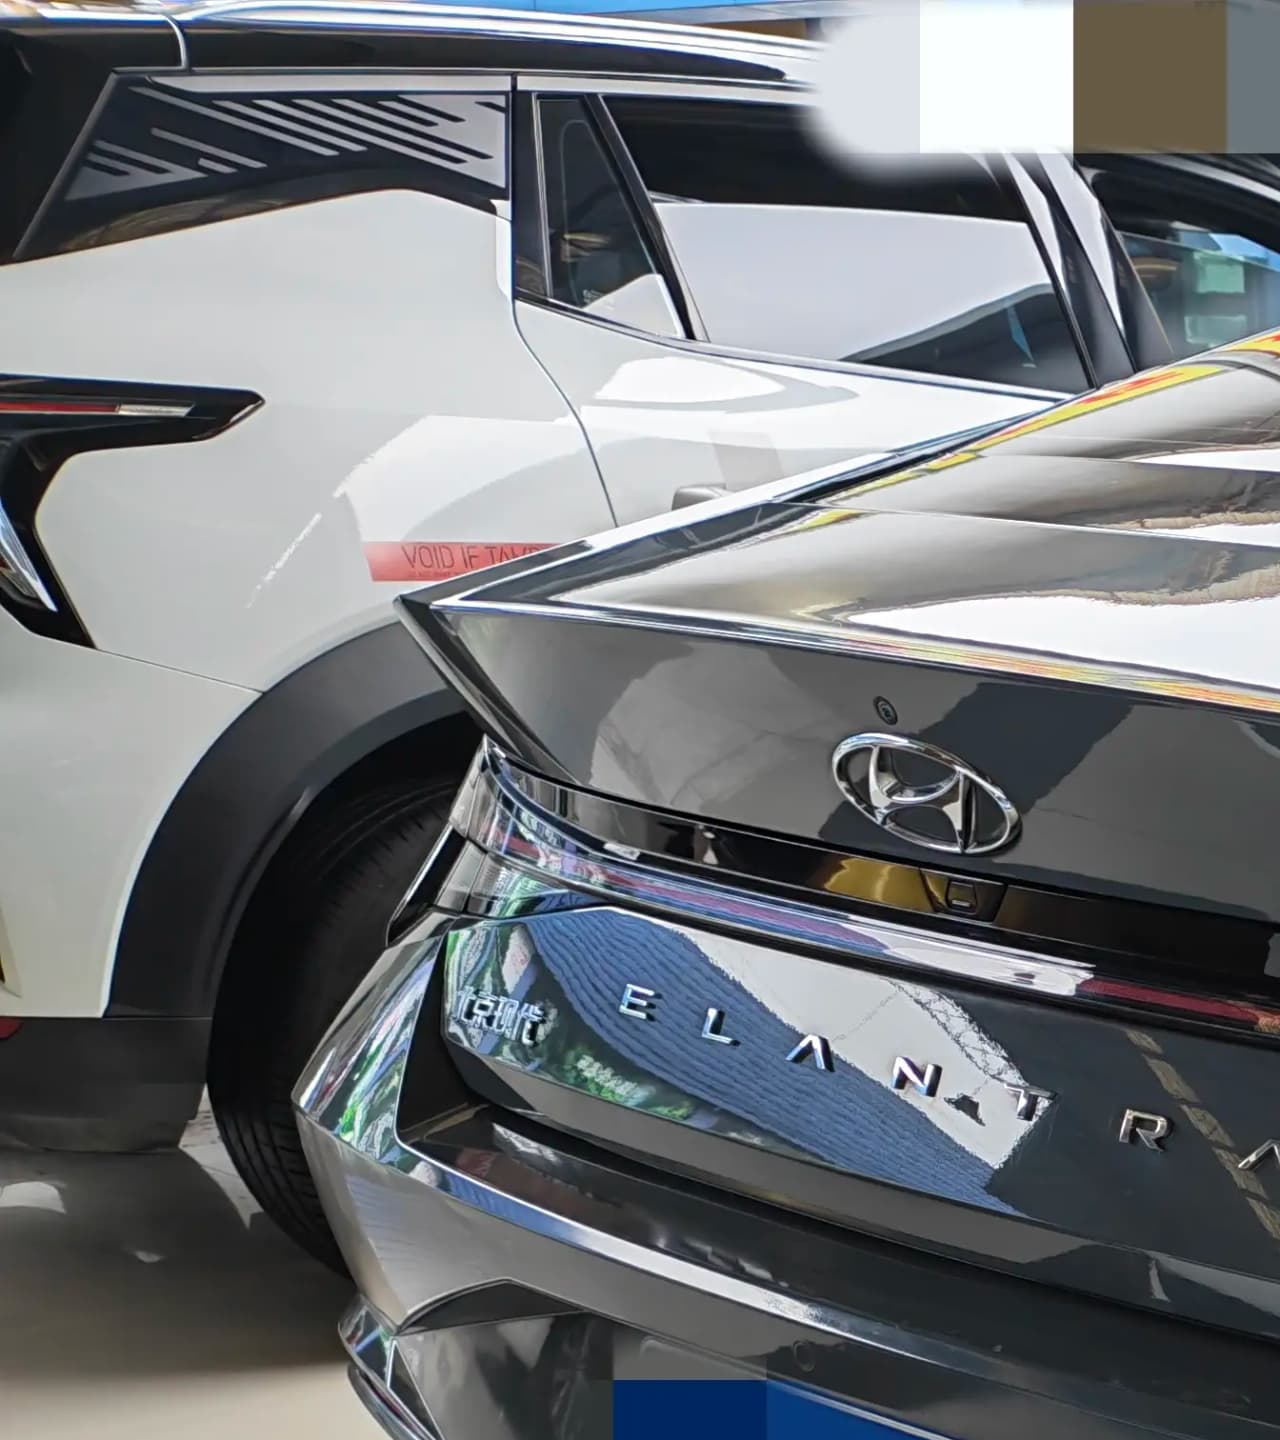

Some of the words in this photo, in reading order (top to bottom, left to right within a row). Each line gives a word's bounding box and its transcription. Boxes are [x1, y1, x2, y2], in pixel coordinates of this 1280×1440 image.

[401, 545, 454, 569] VOID
[460, 545, 479, 569] IF
[454, 985, 545, 1046] 北京现代
